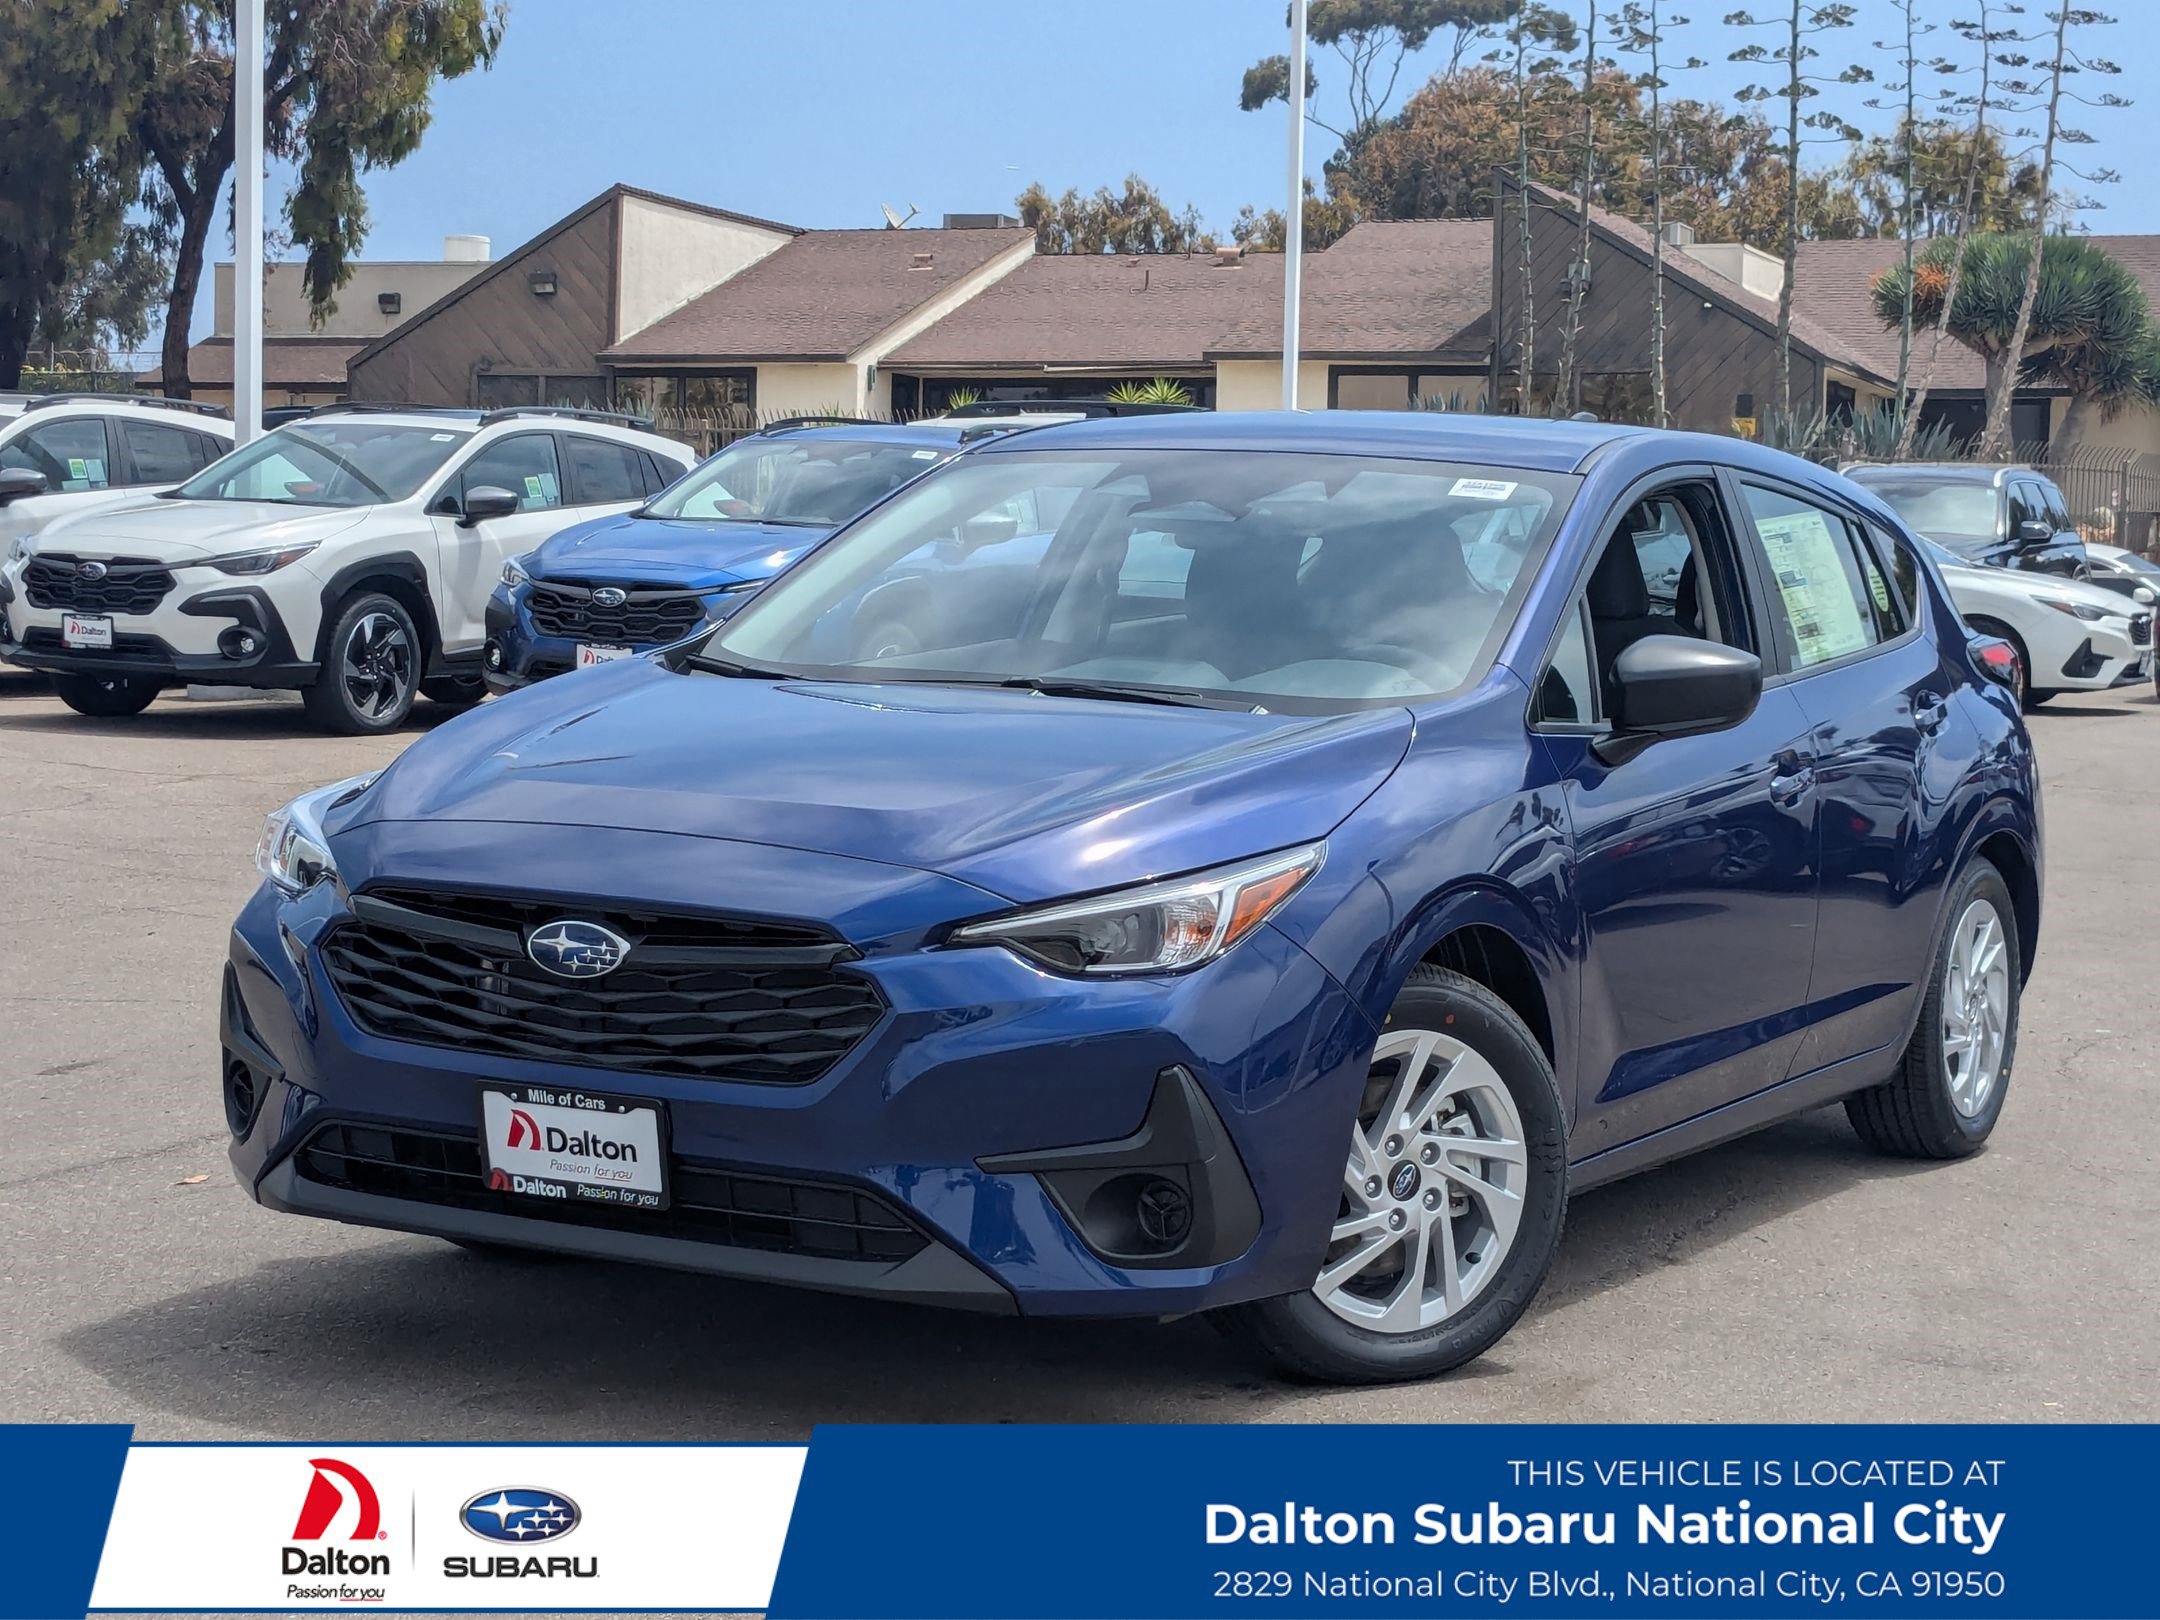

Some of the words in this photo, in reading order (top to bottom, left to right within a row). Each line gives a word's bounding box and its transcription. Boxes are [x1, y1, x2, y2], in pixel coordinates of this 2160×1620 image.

[527, 1088, 555, 1105] Mile
[558, 1093, 572, 1107] of
[575, 1094, 606, 1110] Cars
[546, 1126, 638, 1162] Dalton
[550, 1159, 590, 1175] Passion
[593, 1164, 611, 1178] for
[611, 1169, 633, 1181] you
[513, 1176, 567, 1199] Dalton
[577, 1184, 617, 1201] Passion
[620, 1188, 636, 1203] for
[637, 1194, 659, 1206] you
